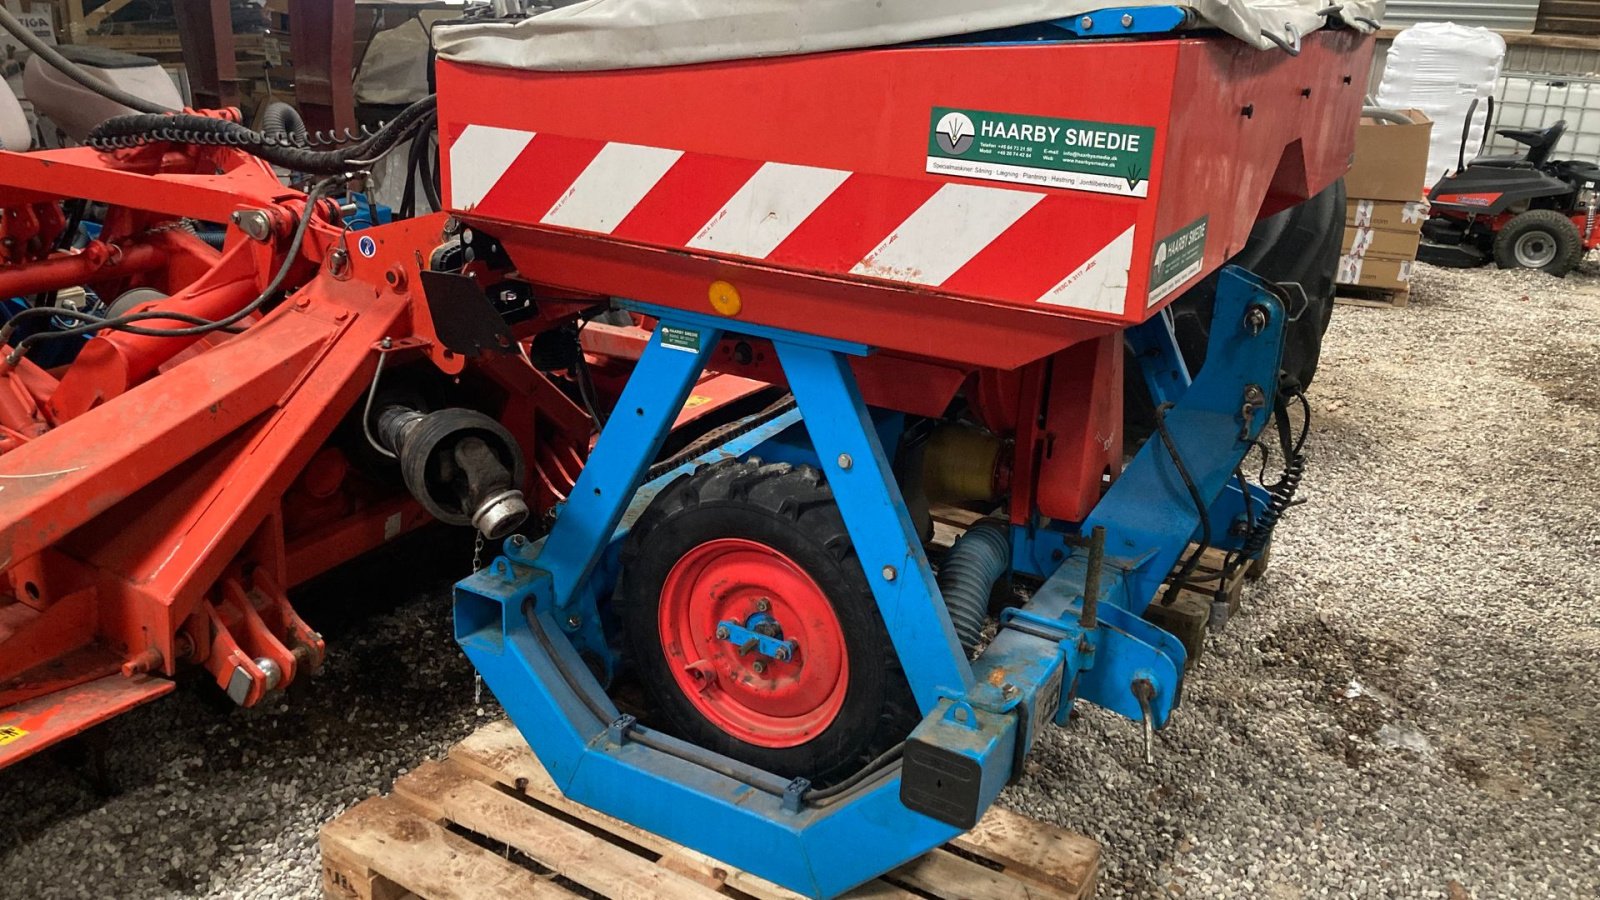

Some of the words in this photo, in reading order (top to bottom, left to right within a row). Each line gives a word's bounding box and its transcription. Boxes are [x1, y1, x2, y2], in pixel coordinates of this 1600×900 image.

[17, 18, 49, 27] TIGA
[981, 120, 1061, 143] HAARBY
[1064, 128, 1140, 152] SMEDIE
[1167, 234, 1188, 257] HAARBY
